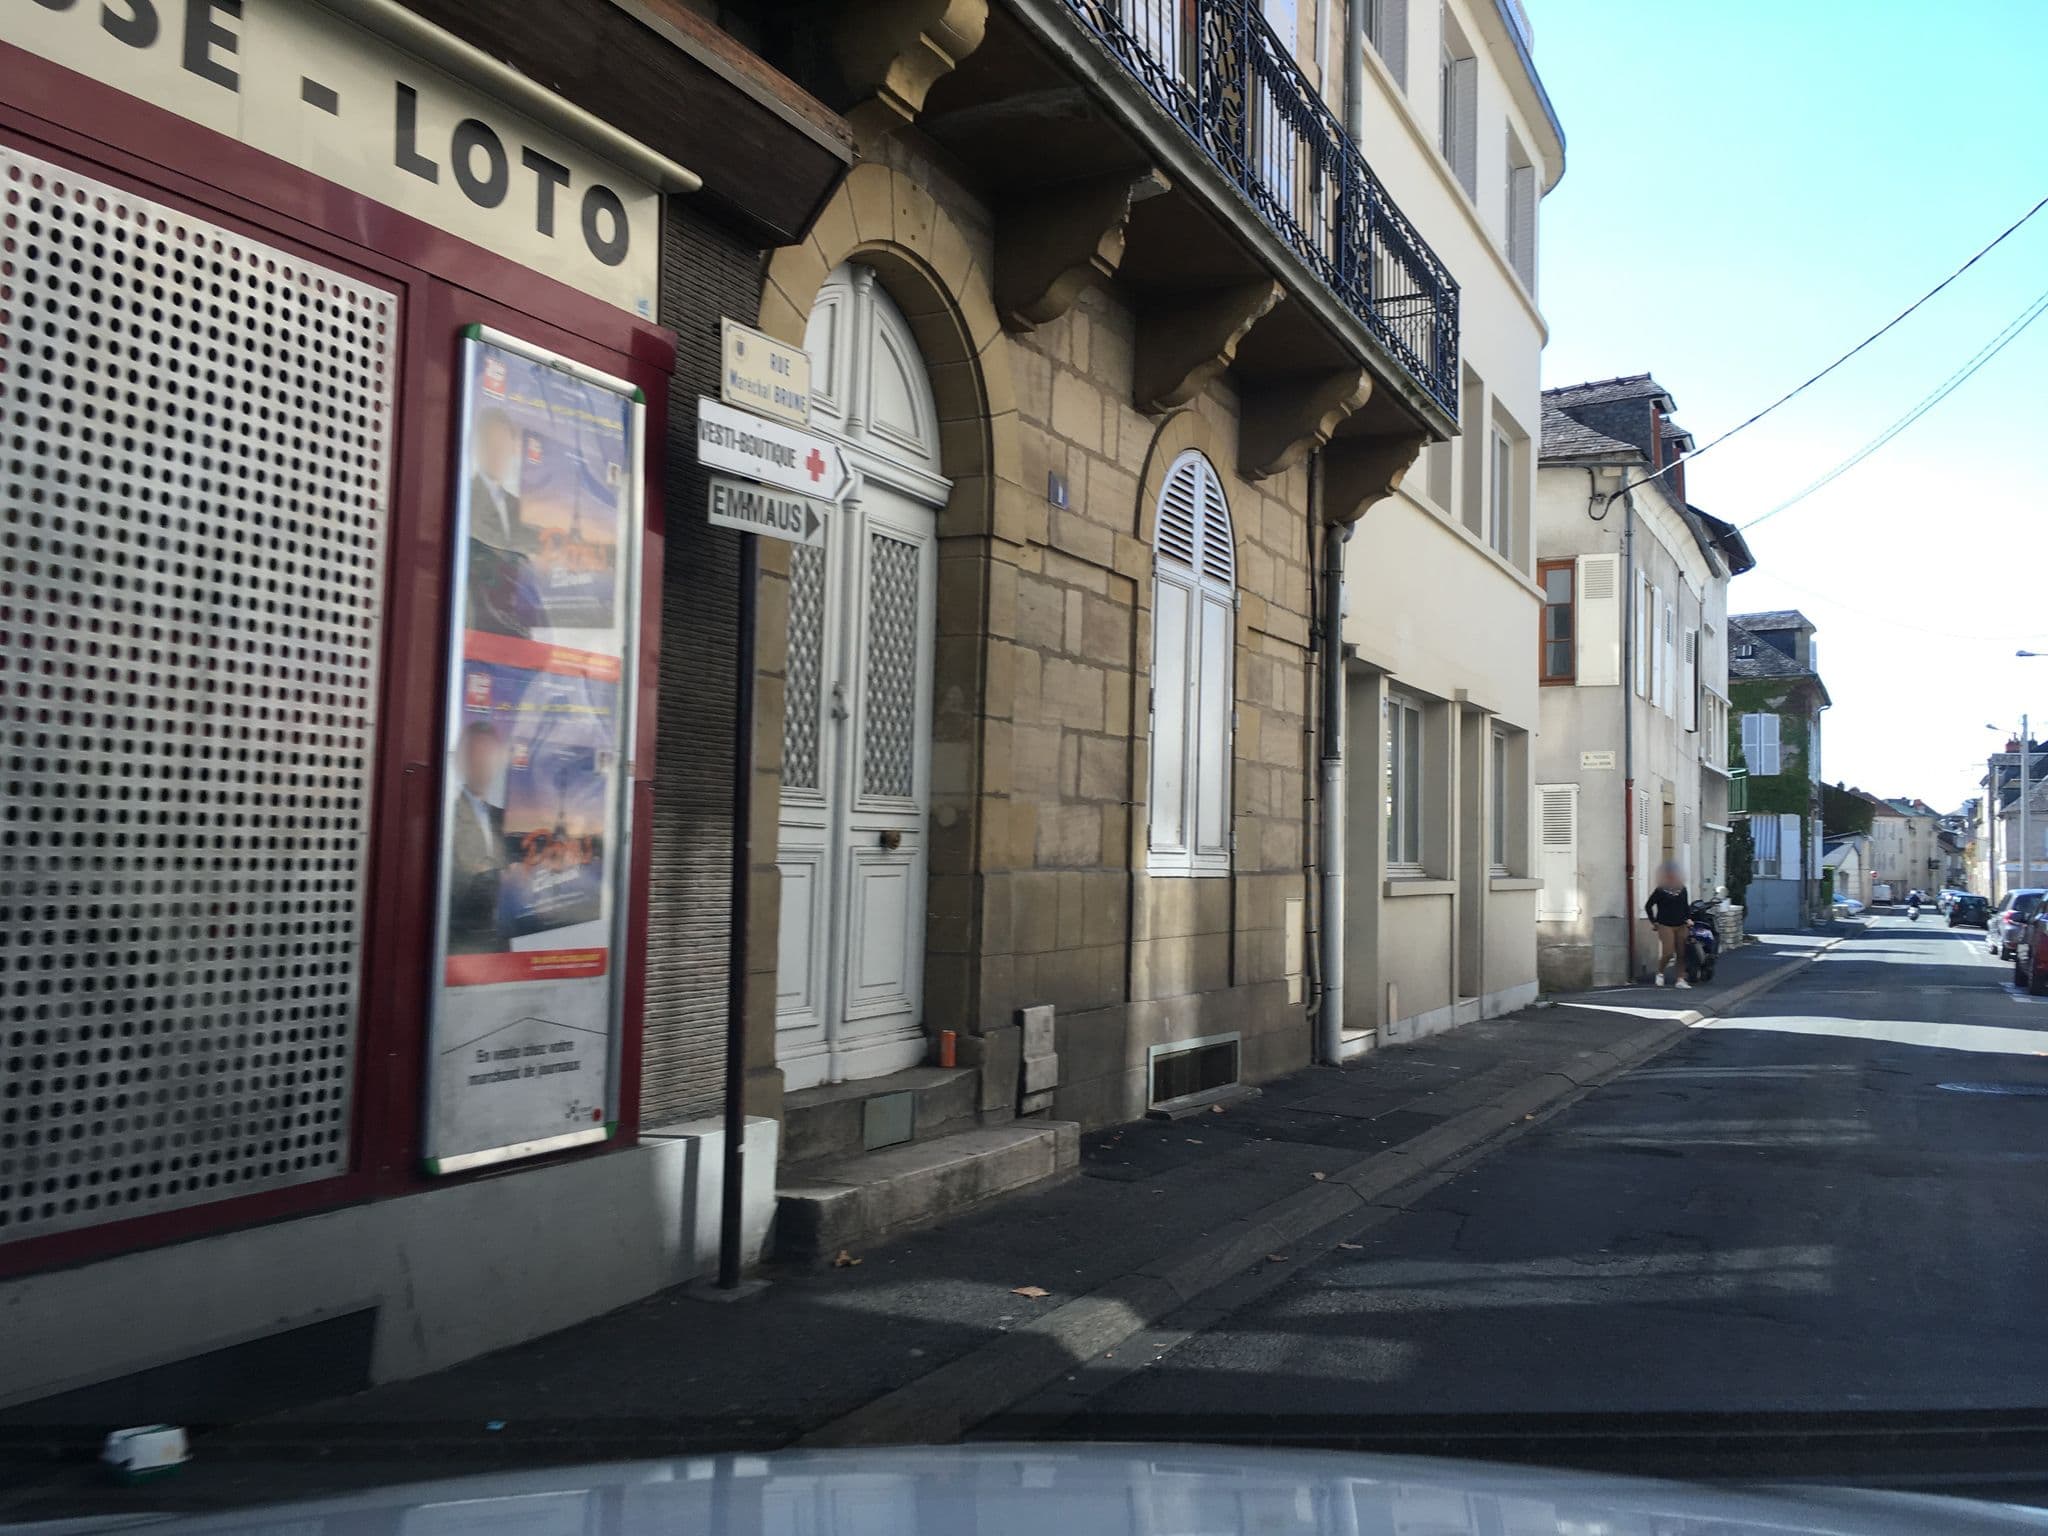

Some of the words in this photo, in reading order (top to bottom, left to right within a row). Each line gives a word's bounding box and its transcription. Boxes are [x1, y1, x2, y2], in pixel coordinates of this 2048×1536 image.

[395, 80, 630, 267] LOTO
[770, 352, 790, 377] RUE
[774, 386, 806, 414] BRUNE
[712, 484, 802, 533] EMMAUS
